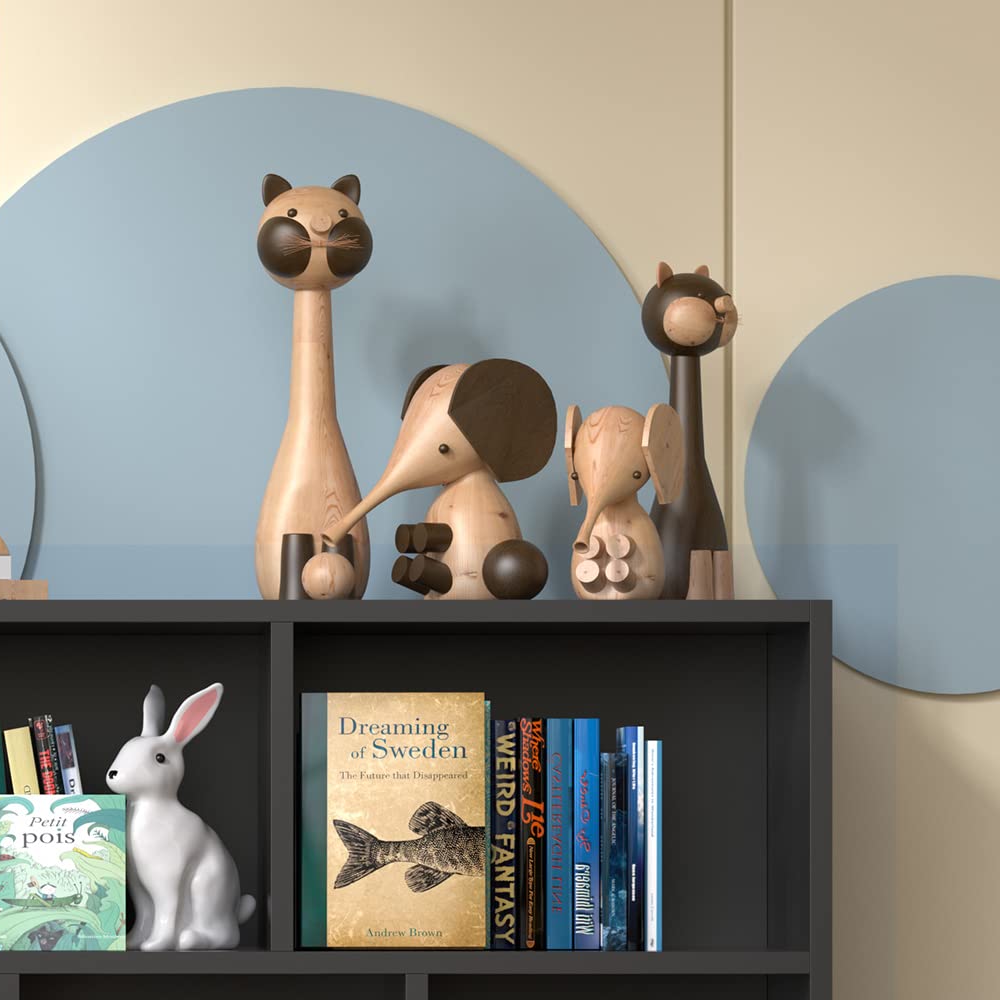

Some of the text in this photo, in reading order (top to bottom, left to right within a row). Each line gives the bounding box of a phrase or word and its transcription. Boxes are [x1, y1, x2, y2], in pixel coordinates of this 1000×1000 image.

[338, 716, 450, 740] Dreaming
[350, 737, 468, 760] of Sweden
[530, 718, 544, 773] Where
[39, 748, 50, 770] THE
[520, 718, 533, 800] Shadows
[339, 770, 468, 783] The Future that Disappeared
[29, 816, 68, 828] Petit
[22, 828, 76, 848] pois
[495, 734, 517, 945] WEIRD FANTASY
[366, 928, 443, 938] Andrew Brown
